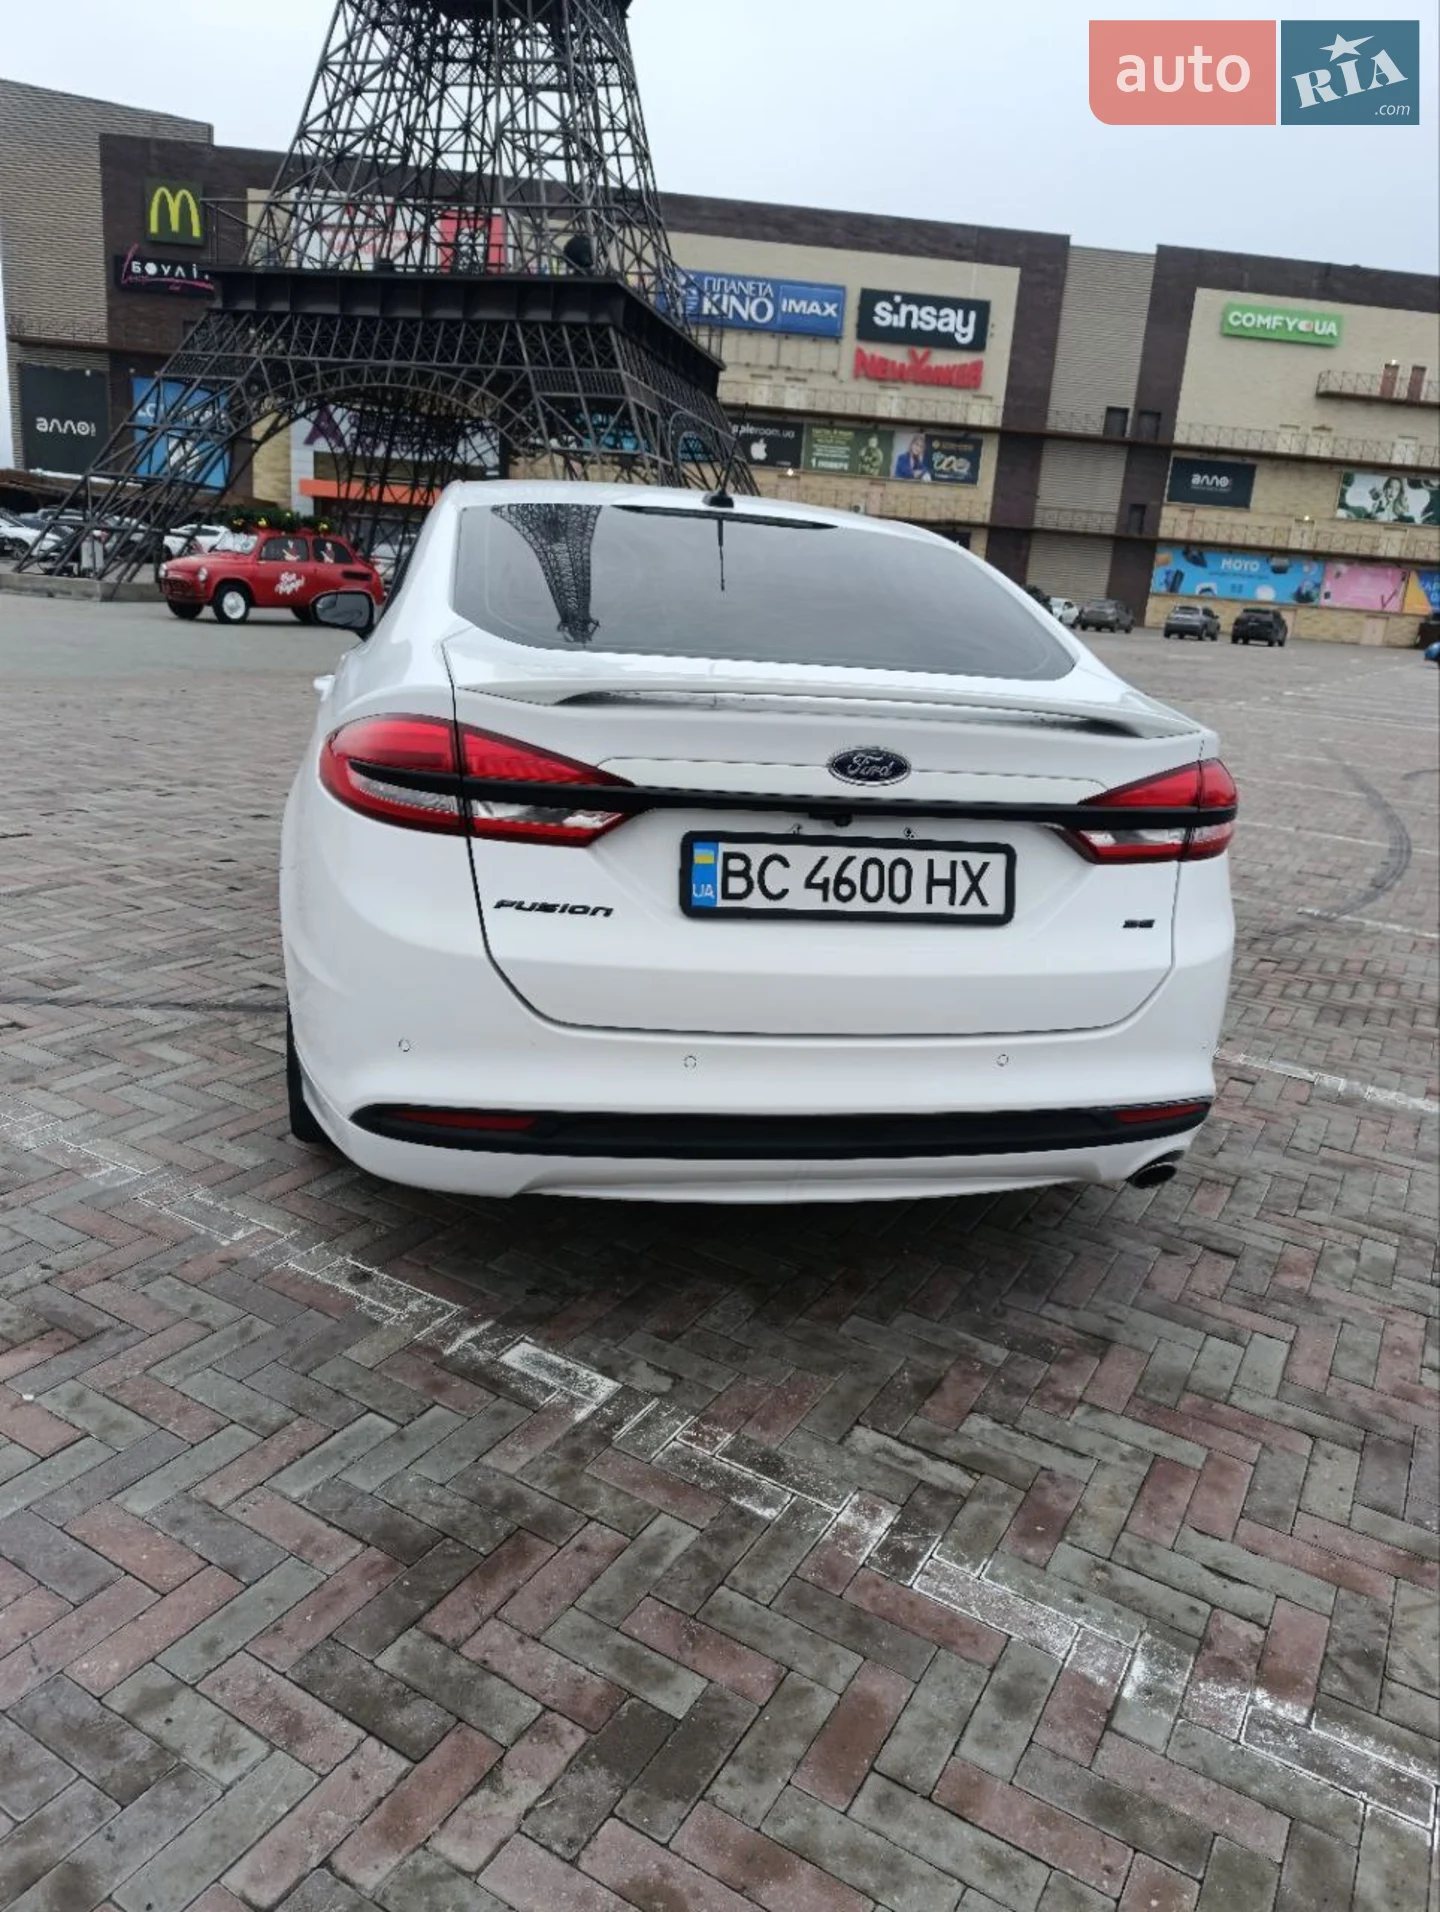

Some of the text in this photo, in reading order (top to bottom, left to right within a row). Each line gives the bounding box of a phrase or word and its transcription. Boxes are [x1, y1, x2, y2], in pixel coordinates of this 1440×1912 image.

[701, 293, 775, 324] KINO
[781, 297, 839, 318] IMAX
[872, 294, 977, 345] sinsay
[847, 753, 896, 776] Ford
[692, 883, 716, 899] UA
[721, 851, 991, 907] BC 4600 HX
